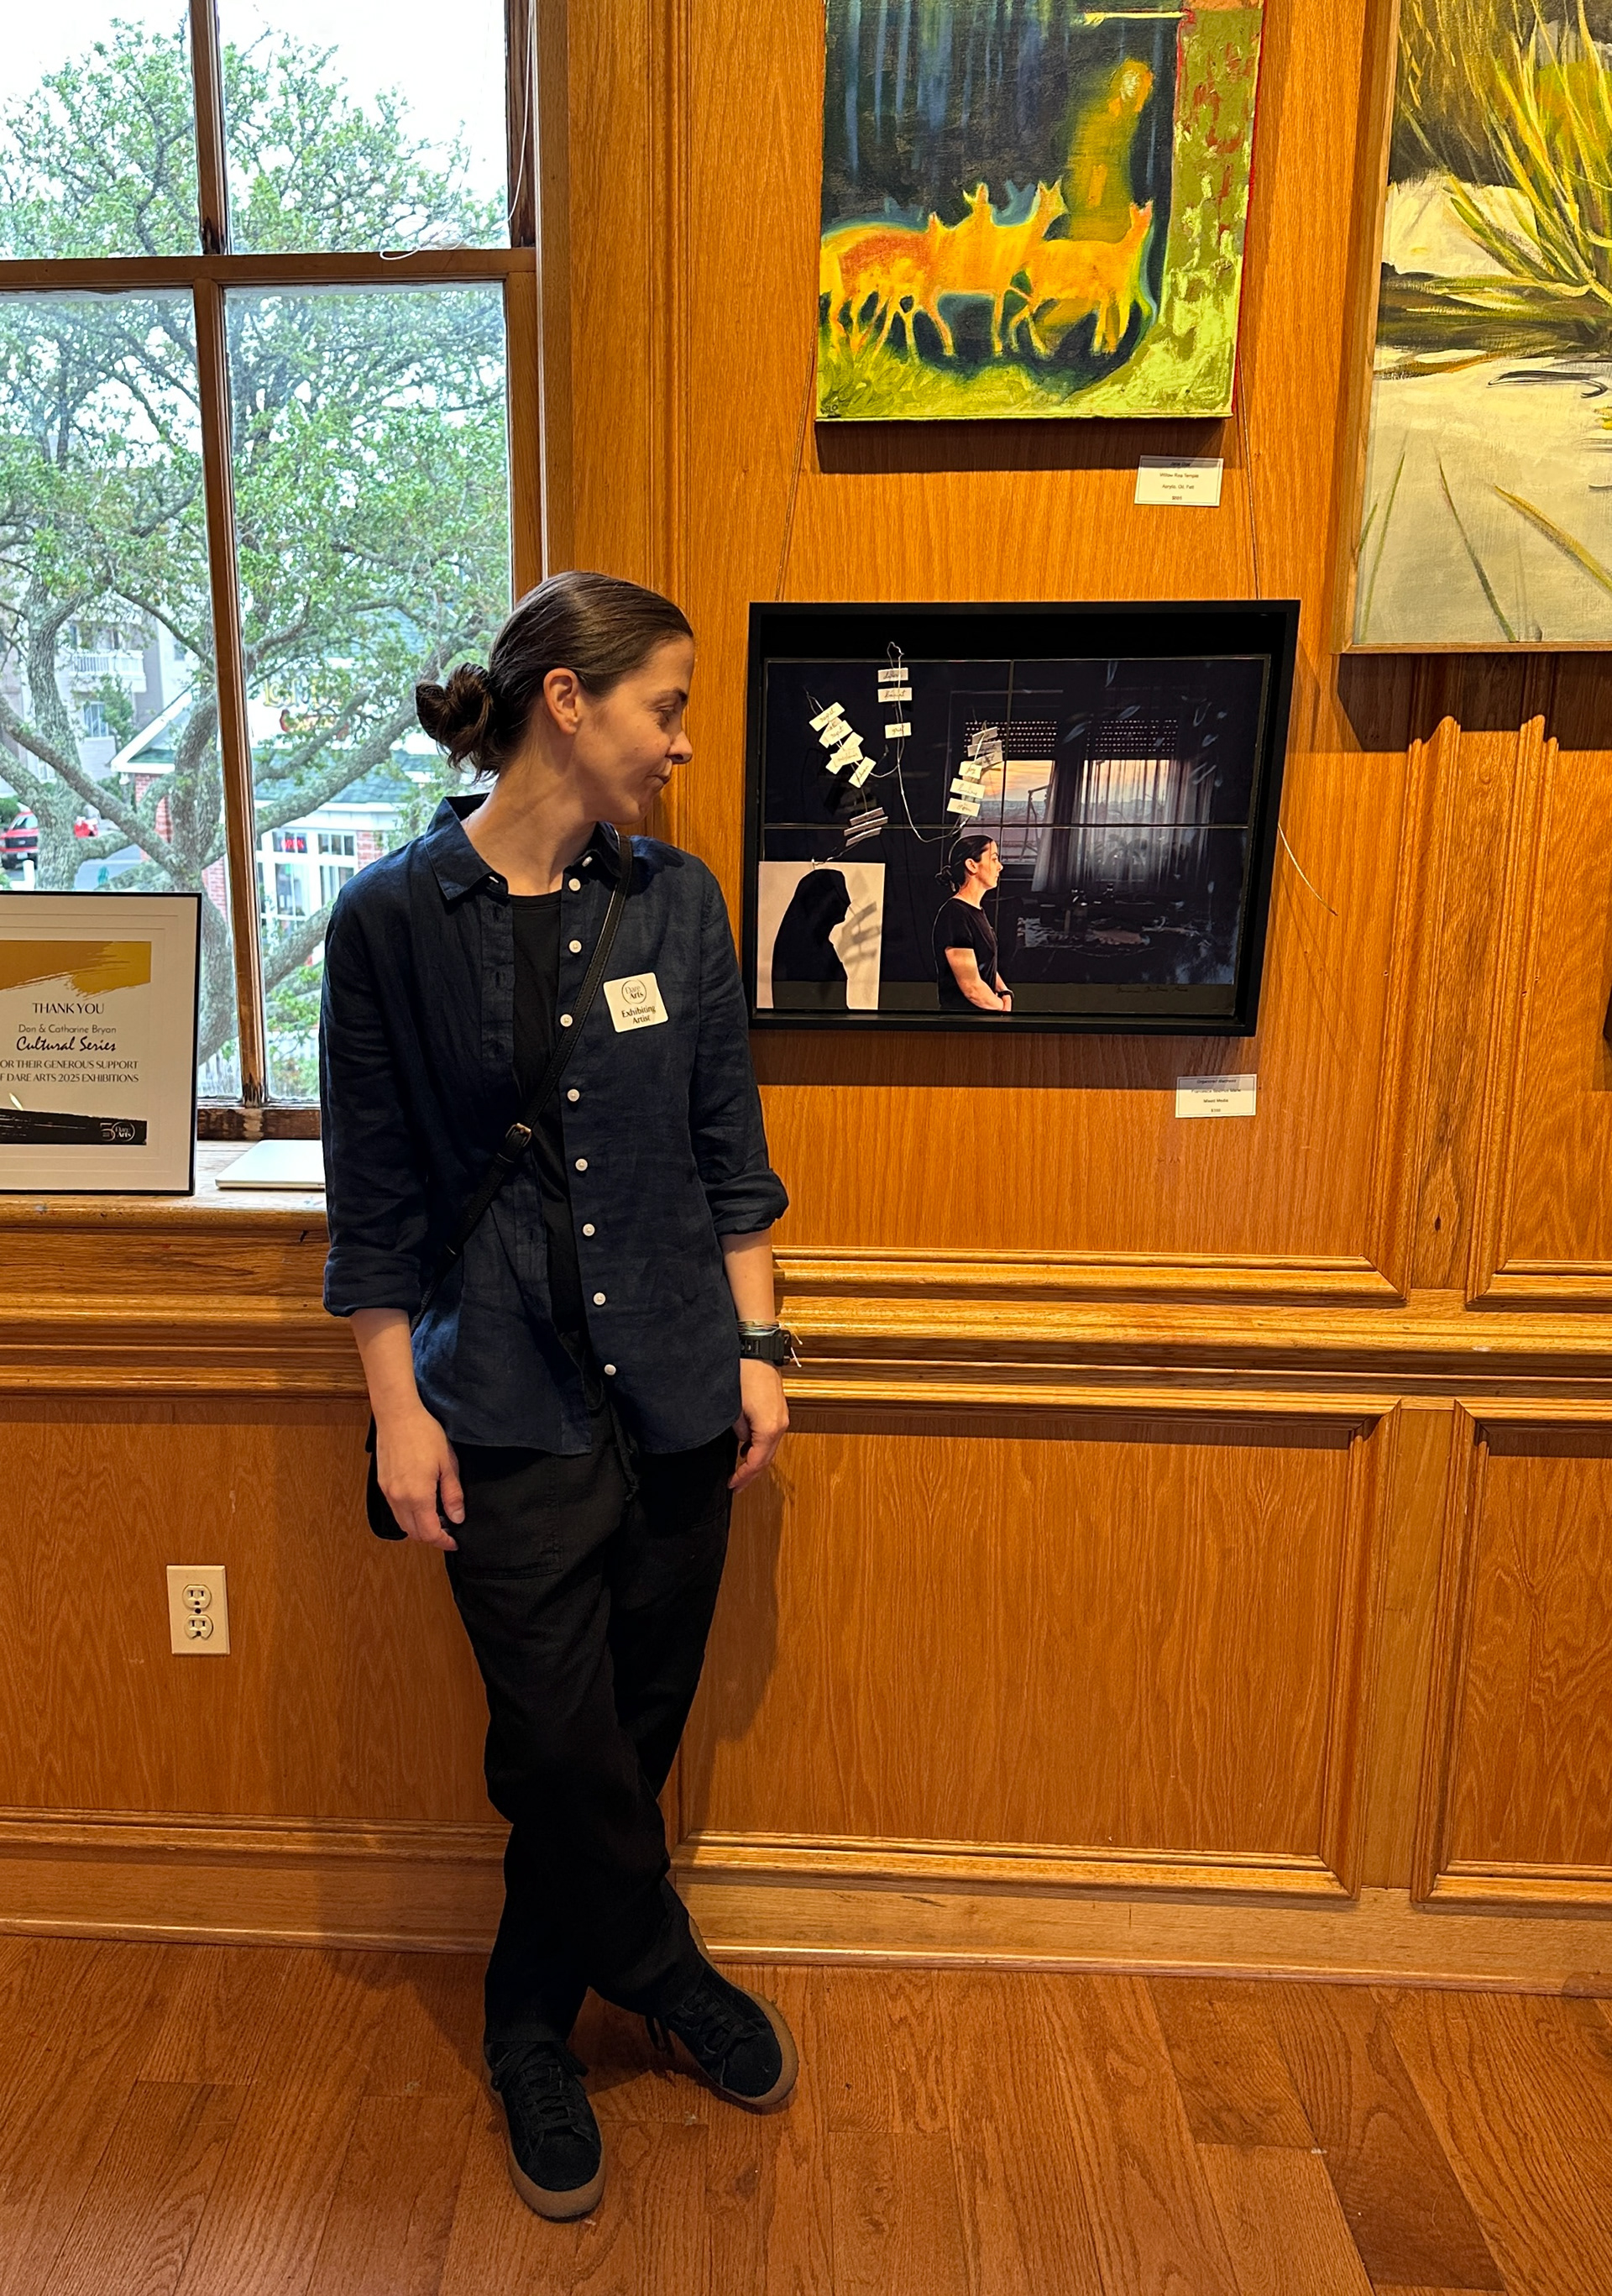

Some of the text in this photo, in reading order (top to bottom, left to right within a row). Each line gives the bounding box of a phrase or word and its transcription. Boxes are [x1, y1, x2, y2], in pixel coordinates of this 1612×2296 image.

[630, 991, 644, 999] Arts
[32, 1003, 105, 1014] THANK YOU
[621, 1005, 657, 1019] Exhibiting
[632, 1014, 651, 1025] Artist
[39, 1024, 46, 1034] &
[48, 1024, 90, 1034] Catharine
[92, 1024, 117, 1035] Bryan
[16, 1035, 117, 1052] Cultural Series
[16, 1059, 43, 1069] THEIR
[44, 1060, 94, 1069] GENEROUS
[96, 1060, 139, 1070] SUPPORT
[7, 1072, 32, 1082] DARE
[33, 1073, 57, 1082] ARTS
[58, 1073, 81, 1082] 2025
[81, 1073, 139, 1083] EXHIBITIONS
